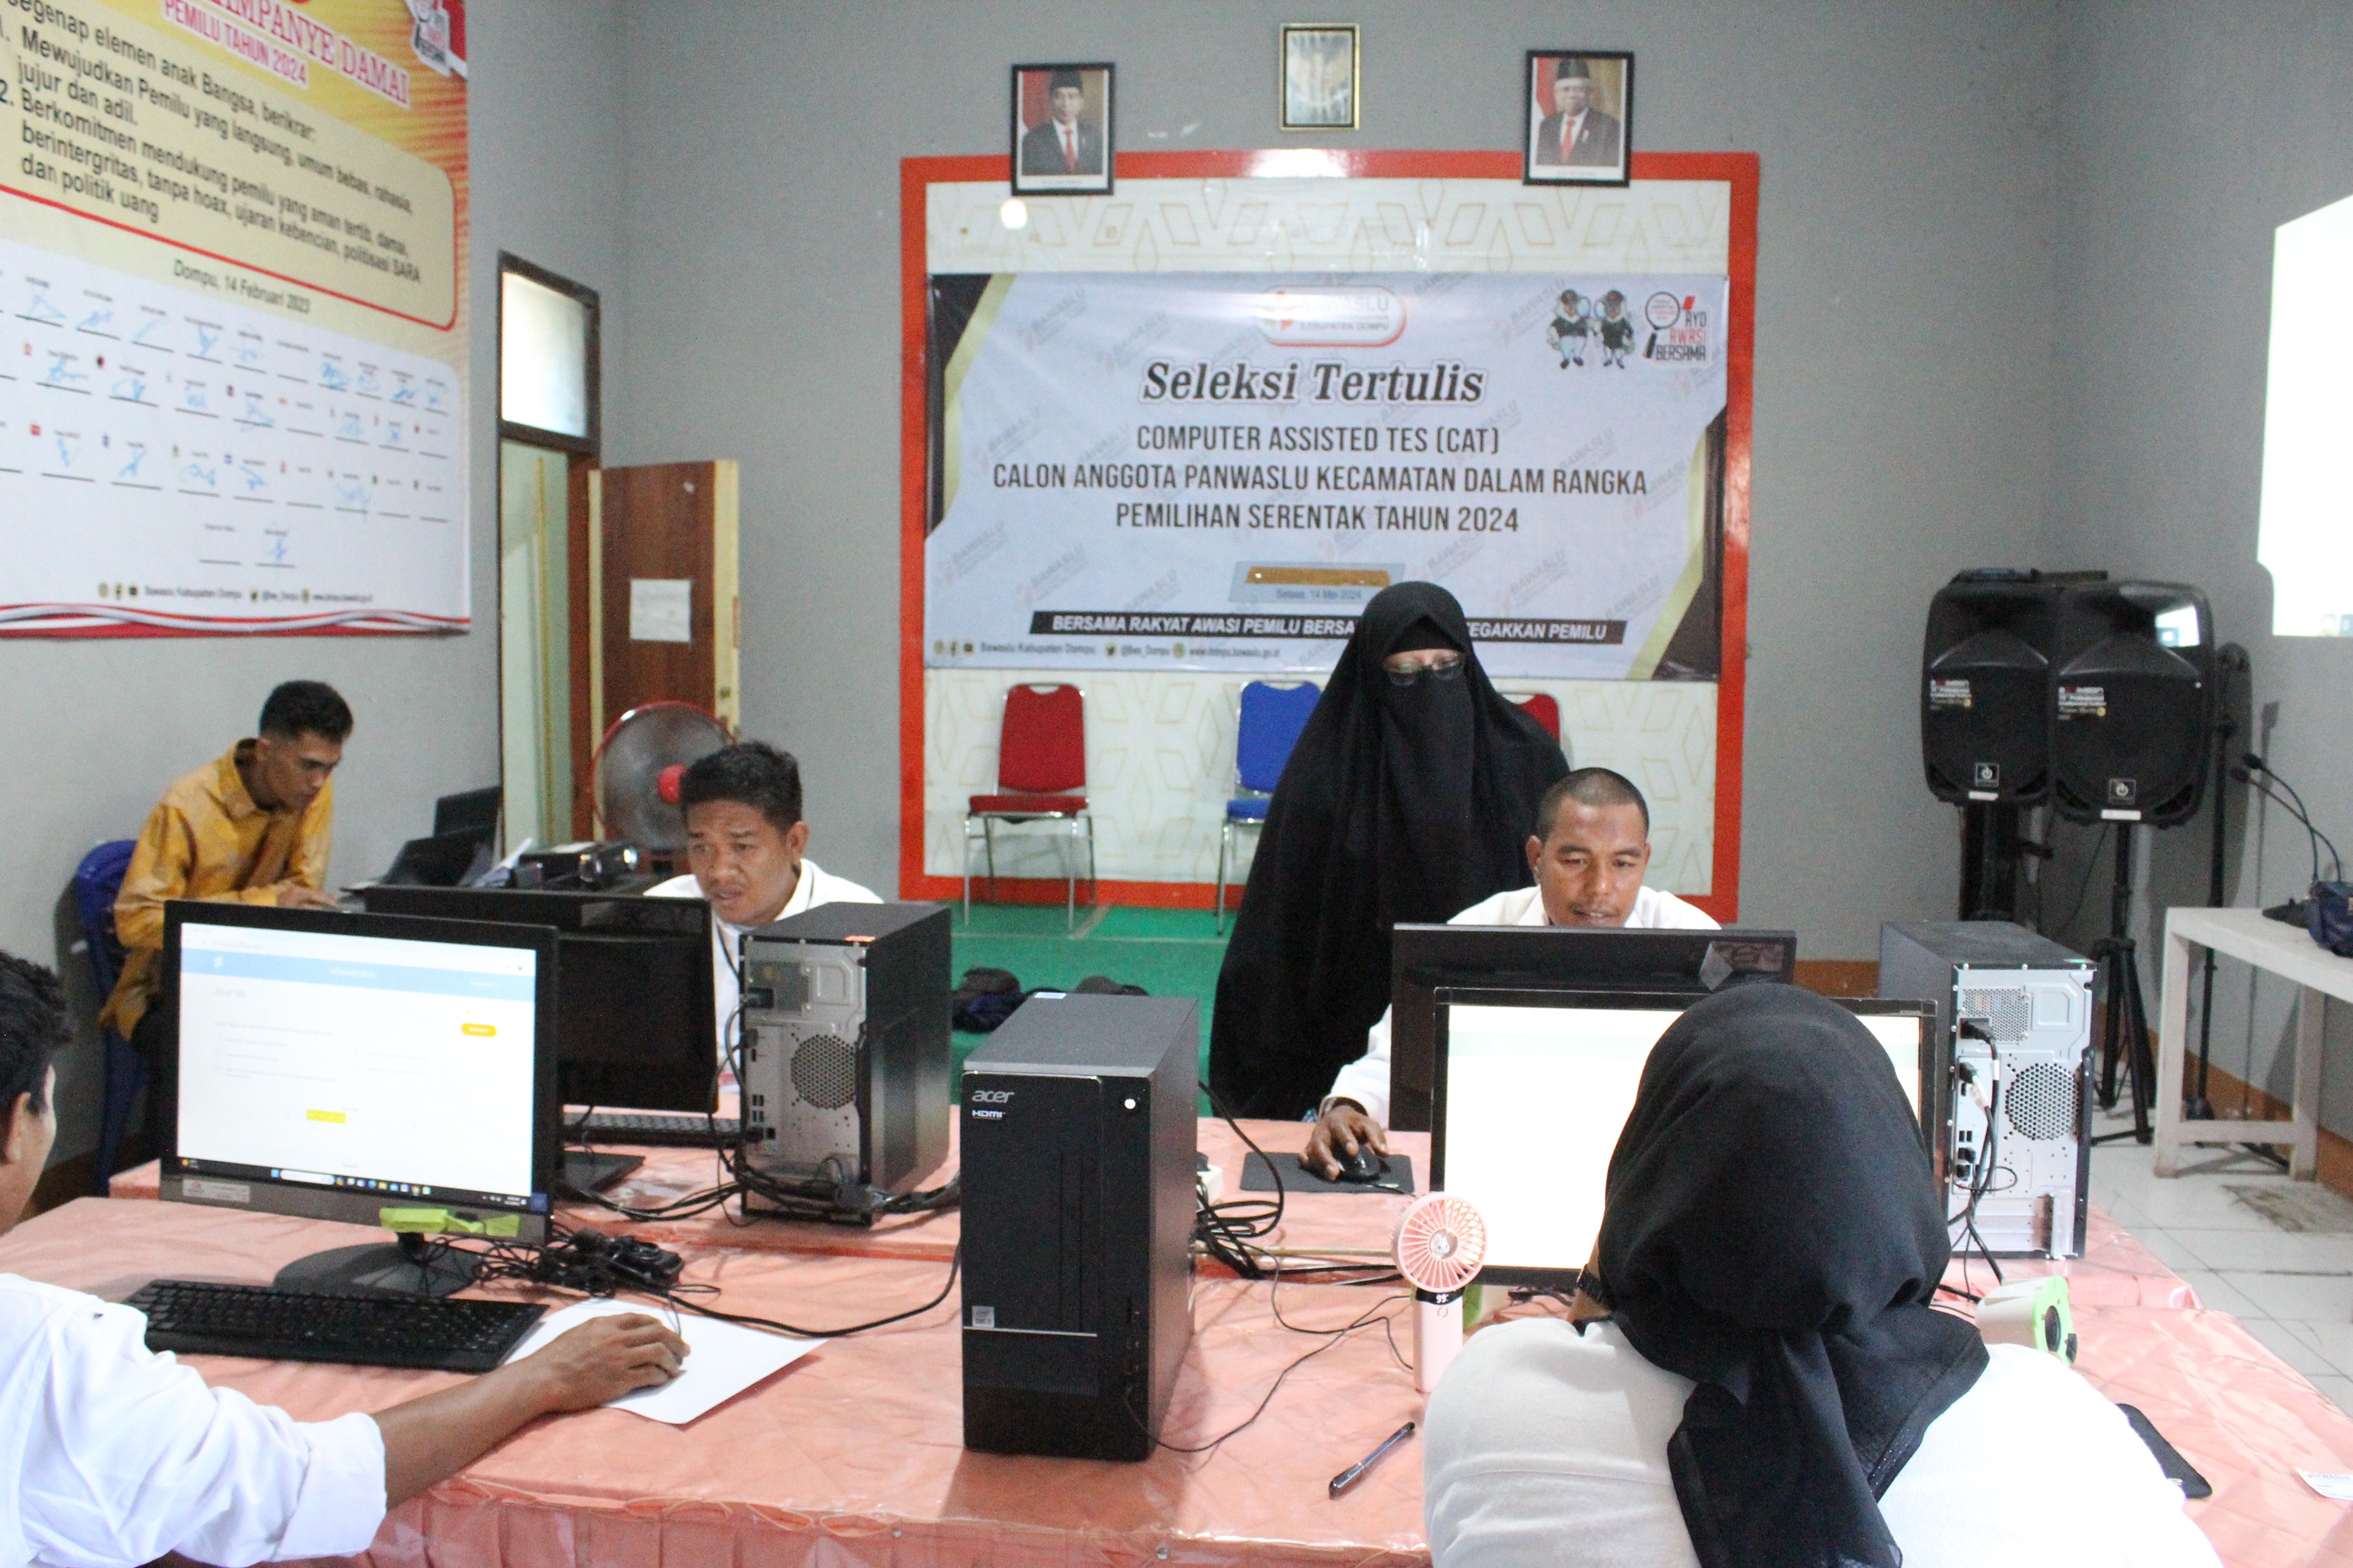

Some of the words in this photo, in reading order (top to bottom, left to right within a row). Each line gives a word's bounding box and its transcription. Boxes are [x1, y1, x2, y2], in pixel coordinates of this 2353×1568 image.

[165, 0, 220, 42] PEMILU
[224, 22, 269, 67] TAHUN
[273, 48, 307, 86] 2024
[18, 55, 62, 93] jujur
[68, 79, 99, 110] dan
[103, 96, 138, 126] adil.
[21, 25, 134, 95] Mewujudkan
[138, 77, 191, 119] Pemilu
[194, 107, 228, 140] yang
[232, 120, 293, 167] langsung,
[95, 26, 157, 71] elemen
[161, 58, 198, 89] anak
[202, 72, 256, 123] Bangsa,
[340, 38, 410, 105] DAMAI
[21, 86, 137, 153] Berkomitmen
[141, 140, 228, 193] mendukung
[231, 176, 276, 206] pemilu
[278, 194, 308, 224] yang
[21, 152, 57, 185] dan
[62, 168, 115, 207] politik
[120, 189, 160, 224] uang
[21, 118, 143, 186] berintergritas,
[147, 168, 190, 202] tanpa
[194, 185, 231, 220] hoax,
[235, 202, 276, 228] ujaran
[392, 258, 421, 284] SARA
[173, 258, 220, 290] Dompu,
[225, 275, 238, 291] 14
[240, 277, 285, 307] Februari
[1143, 362, 1298, 400] Seleksi
[1314, 364, 1482, 402] Tertulis
[1137, 425, 1261, 451] COMPUTER
[1268, 426, 1378, 452] ASSISTED
[1386, 427, 1429, 453] TES
[993, 463, 1066, 488] CALON
[1073, 464, 1176, 489] ANGGOTA
[1185, 465, 1309, 490] PANWASLU
[1316, 466, 1456, 492] KECAMATAN
[1464, 468, 1545, 494] DALAM
[1553, 468, 1647, 495] RANGKA
[1116, 502, 1240, 528] PEMILIHAN
[1248, 504, 1366, 530] SERENTAK
[1374, 506, 1450, 531] TAHUN
[1458, 506, 1519, 532] 2024
[1018, 643, 1063, 655] Kabupaten
[1065, 644, 1096, 655] Dompu
[1052, 615, 1126, 633] BERSAMA
[1129, 616, 1190, 633] RAKYAT
[1191, 618, 1240, 634] AWASI
[1242, 618, 1301, 635] PEMILU
[1547, 624, 1607, 640] PEMILU
[971, 1110, 1003, 1118] HDMI
[972, 1090, 1015, 1103] acer
